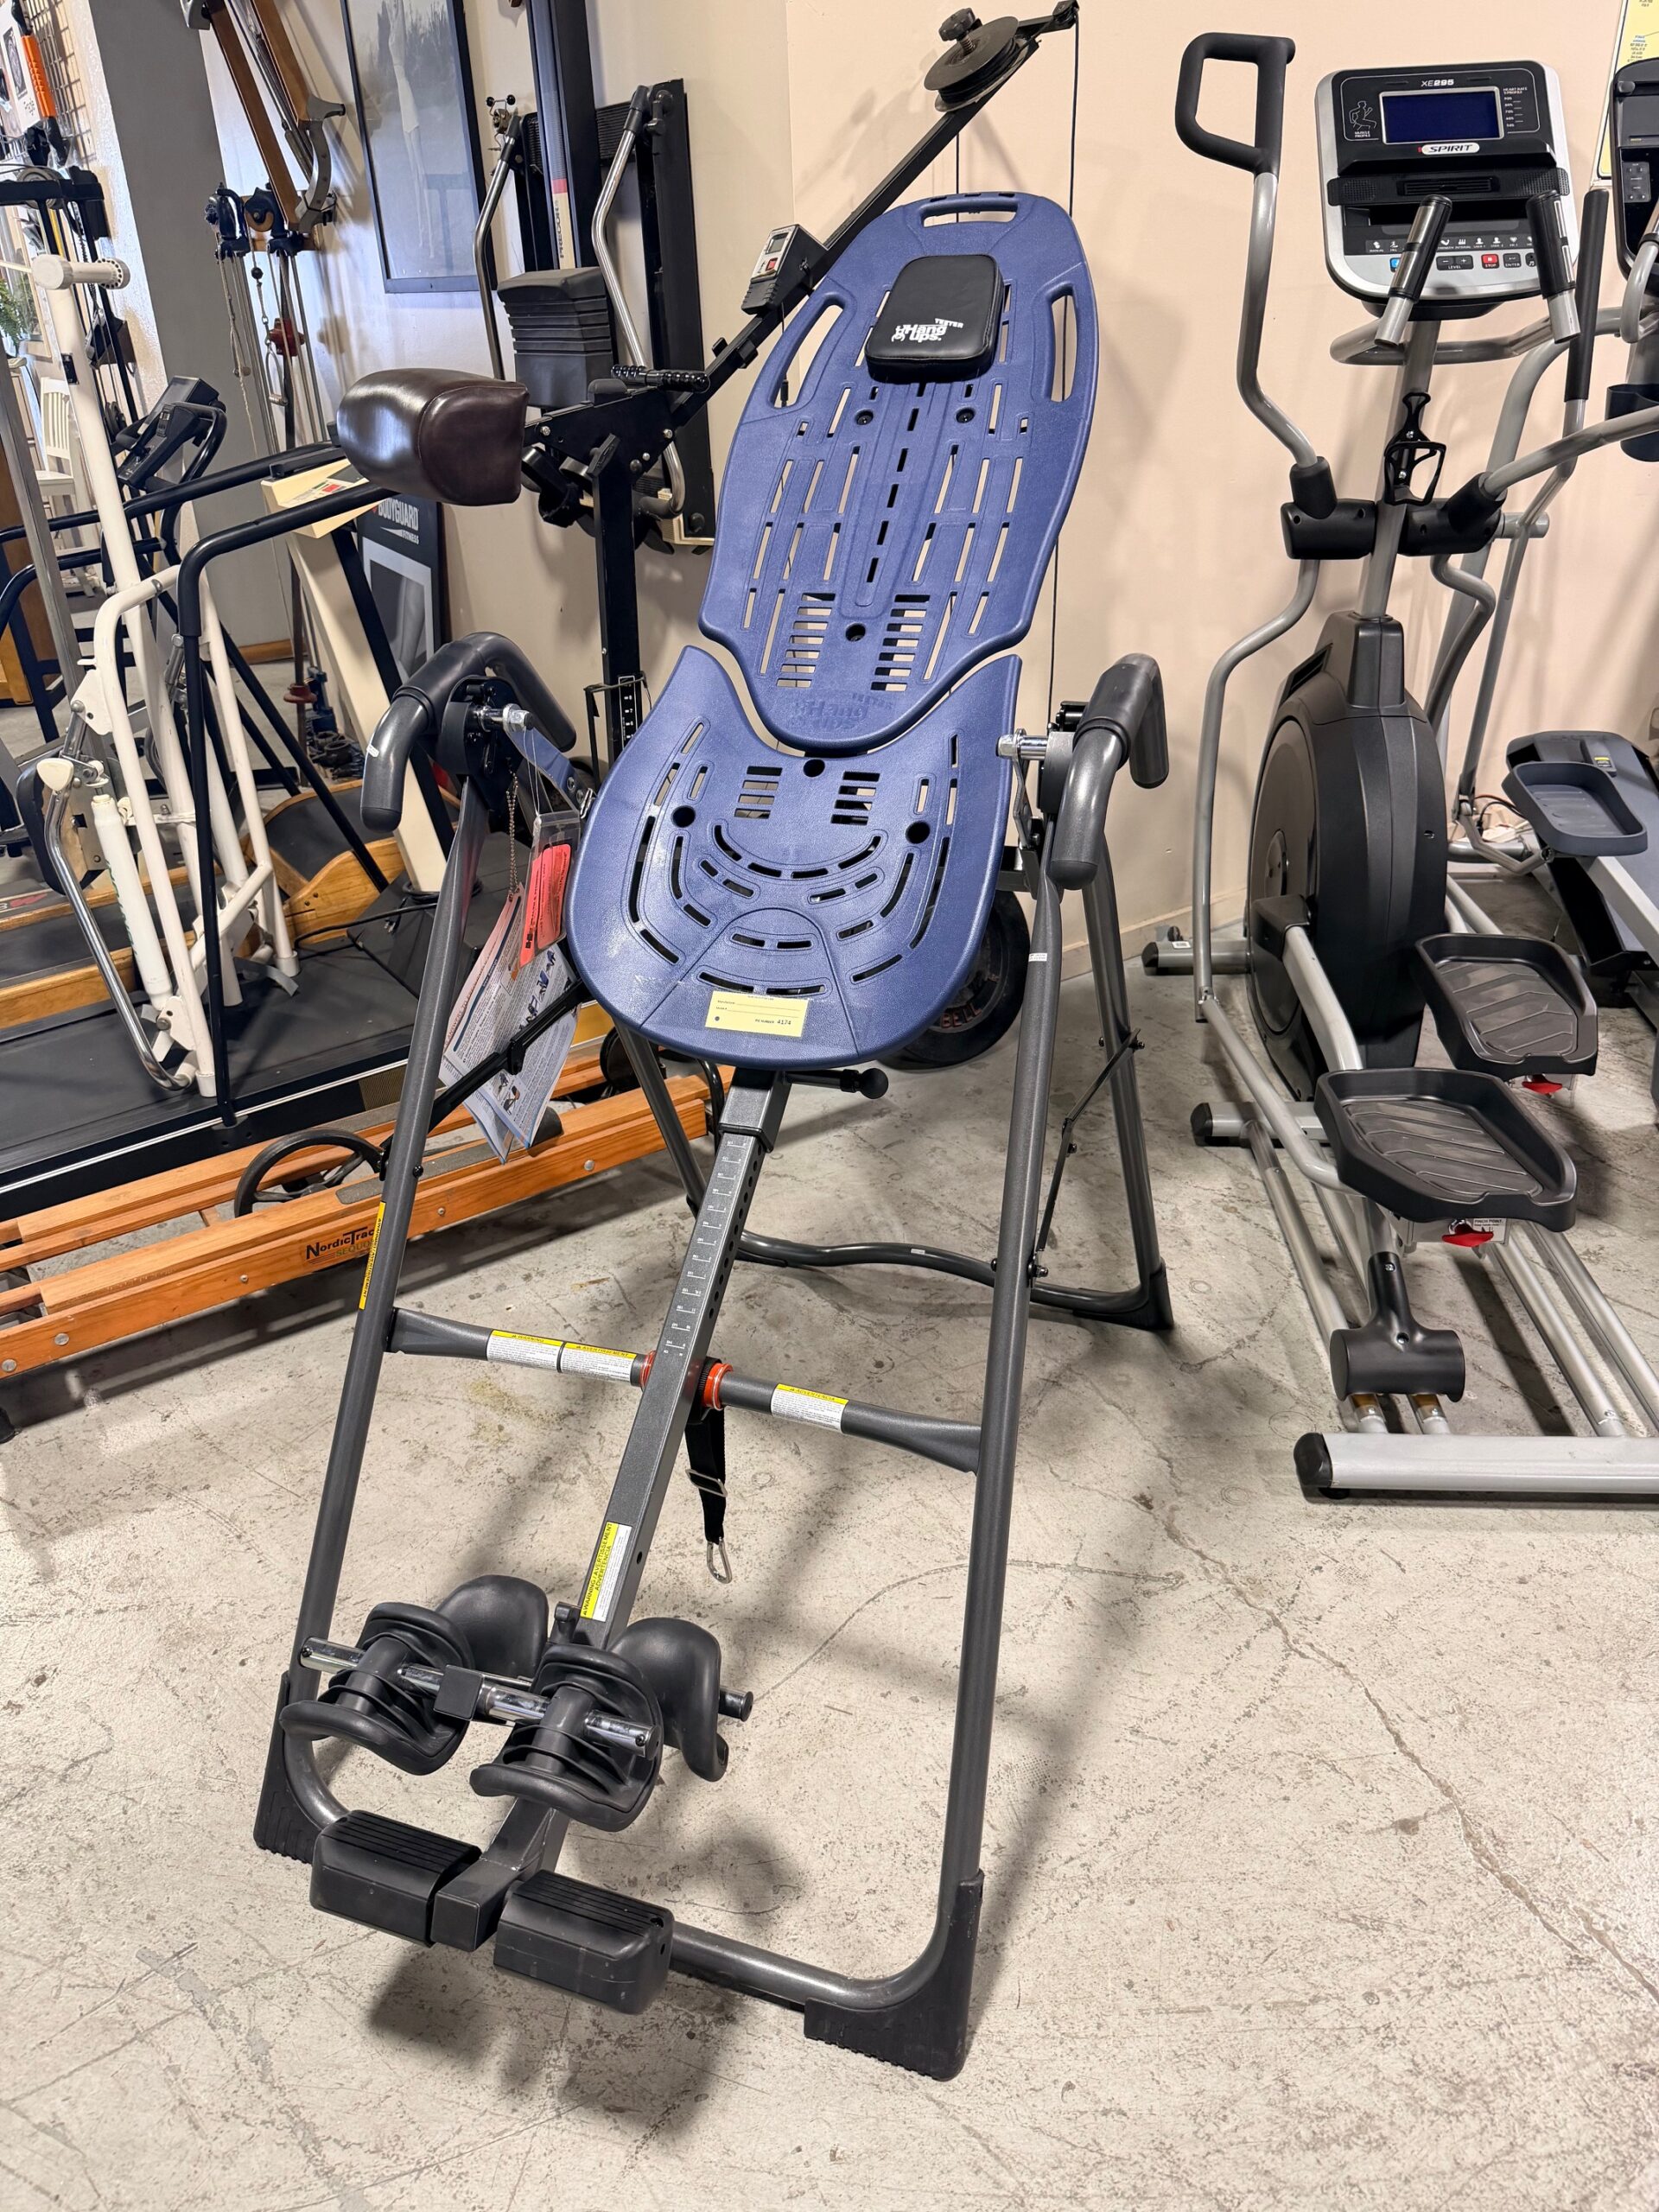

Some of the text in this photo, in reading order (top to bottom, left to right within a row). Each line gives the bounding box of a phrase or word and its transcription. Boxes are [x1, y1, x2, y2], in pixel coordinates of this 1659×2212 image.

[1421, 79, 1455, 87] XE295
[1428, 143, 1473, 153] SPIRIT
[555, 207, 564, 258] PRECOR
[935, 317, 963, 328] TEETER
[378, 497, 419, 531] BODYGUARD
[403, 530, 420, 545] FITNESS
[940, 1002, 982, 1029] BELL
[305, 1226, 374, 1260] NordicTrac
[335, 1241, 372, 1257] SEQUO
[583, 1578, 596, 1612] WARNING
[594, 1522, 613, 1576] AVERTISSEMENT
[595, 1545, 612, 1591] ADVERTENCIA
